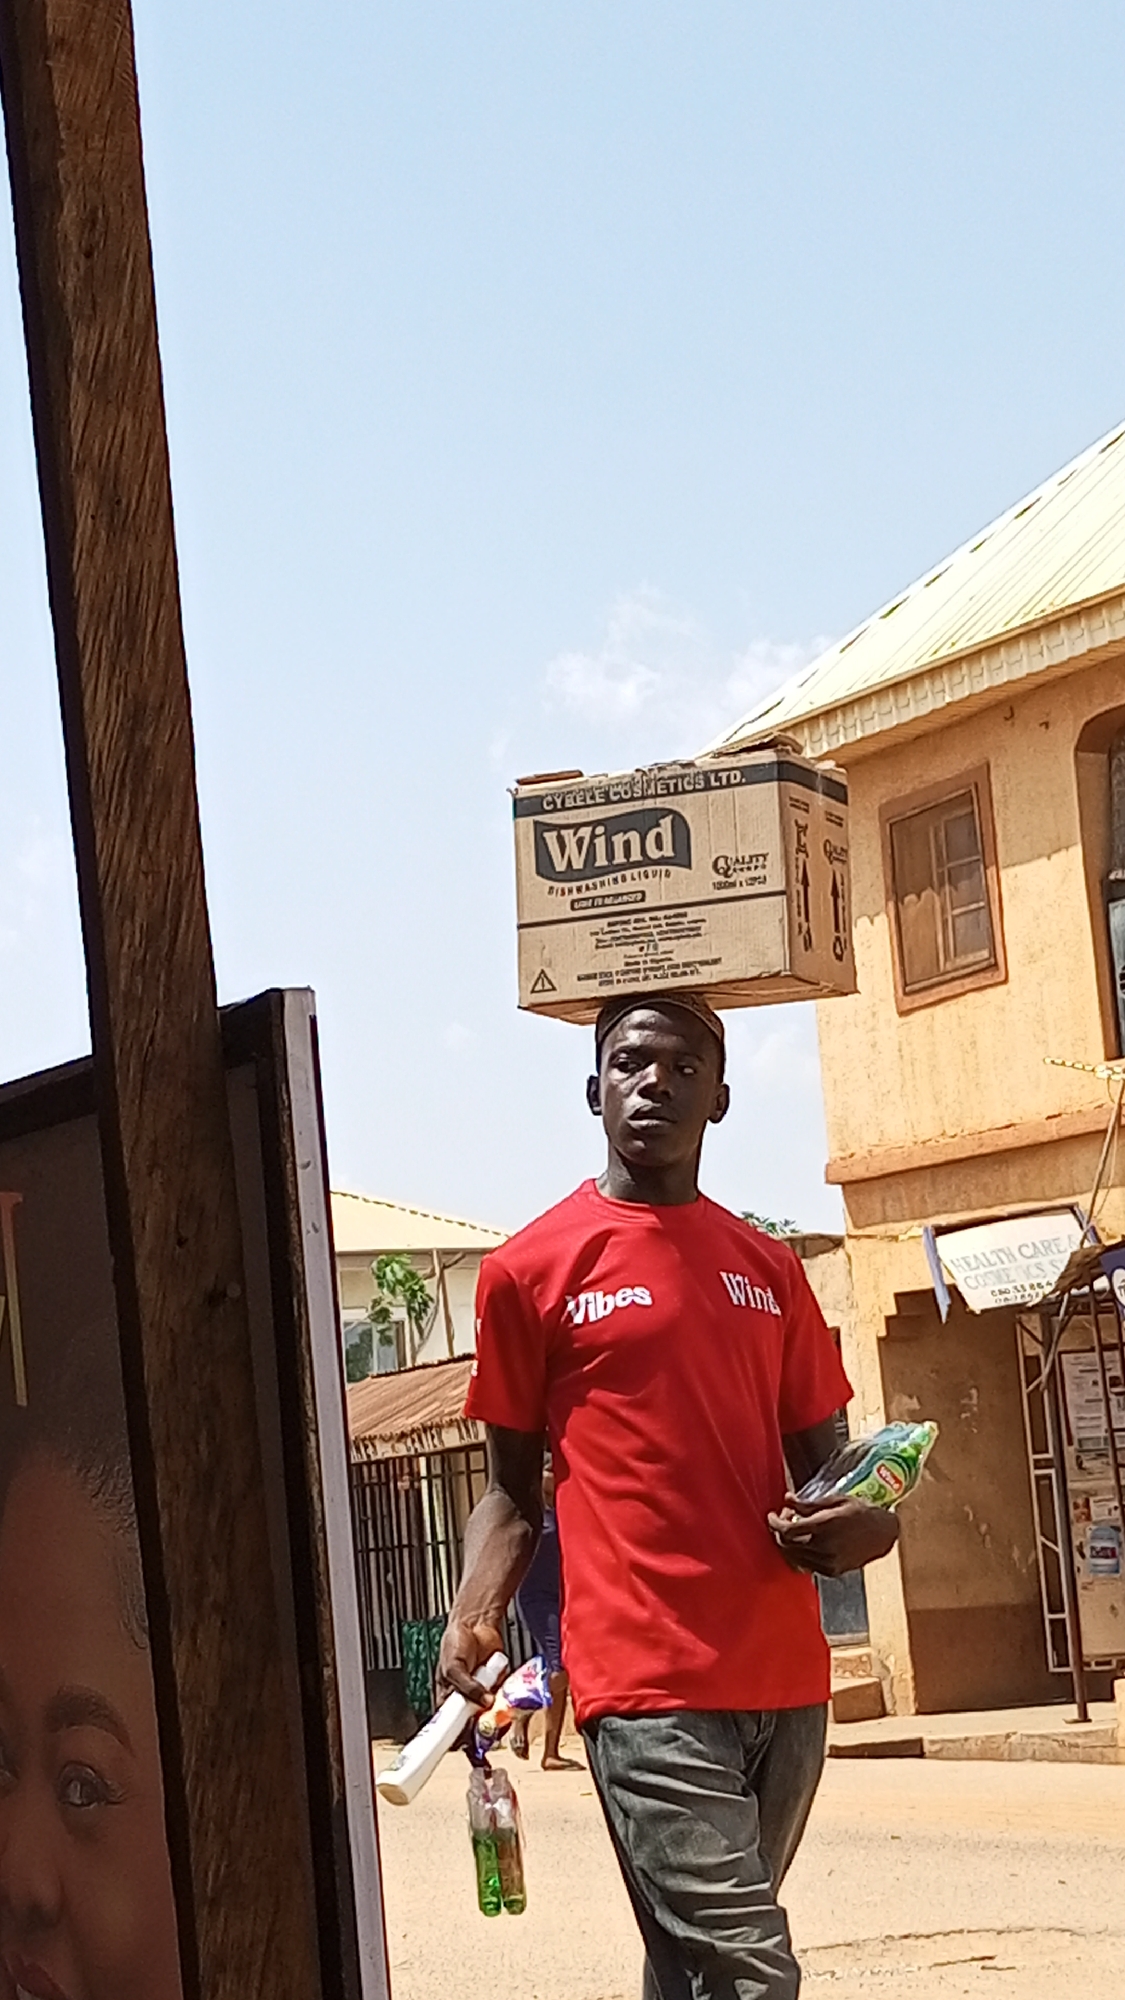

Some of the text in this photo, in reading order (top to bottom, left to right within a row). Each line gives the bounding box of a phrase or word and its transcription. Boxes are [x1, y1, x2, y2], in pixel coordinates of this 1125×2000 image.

[709, 769, 746, 787] LTD.
[543, 814, 675, 873] Wind
[950, 1246, 1017, 1274] HEALTH
[1018, 1237, 1067, 1260] CARE
[565, 1286, 653, 1325] Vibes
